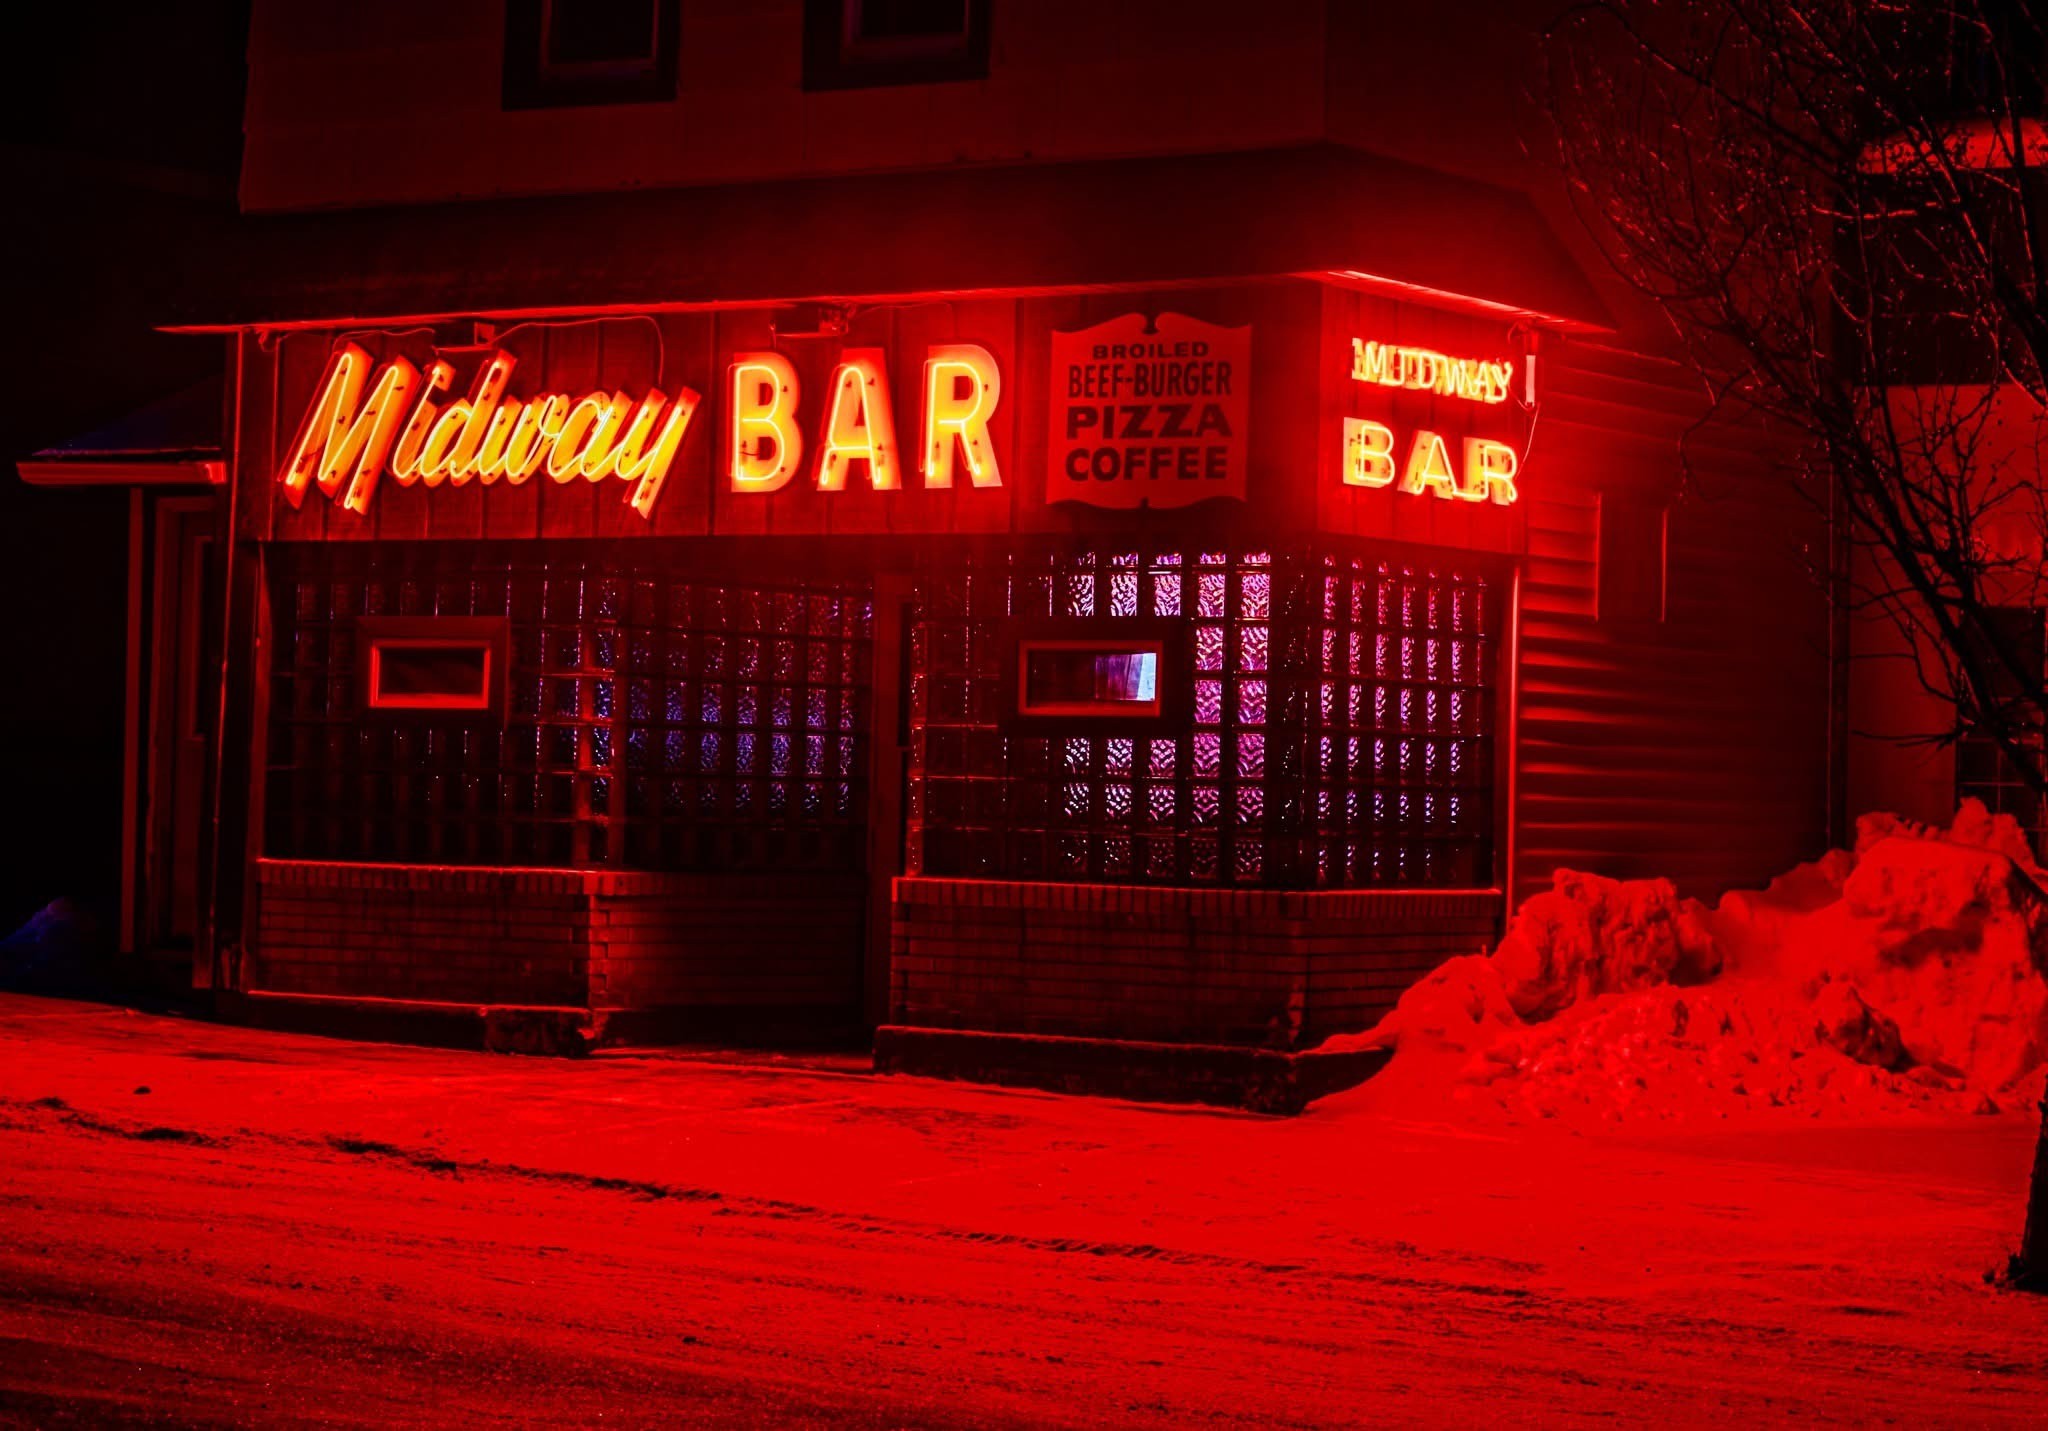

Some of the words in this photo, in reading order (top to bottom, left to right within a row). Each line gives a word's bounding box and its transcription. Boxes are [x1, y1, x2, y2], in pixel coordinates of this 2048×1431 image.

[1092, 341, 1209, 360] BROILED
[1068, 361, 1232, 398] BEEF-BURGER
[1351, 337, 1513, 404] MIDWAY
[278, 342, 700, 518] Midway
[730, 344, 1002, 493] BAR
[1066, 403, 1233, 440] PIZZA
[1065, 446, 1228, 482] COFFEE
[1343, 416, 1518, 506] BAR
